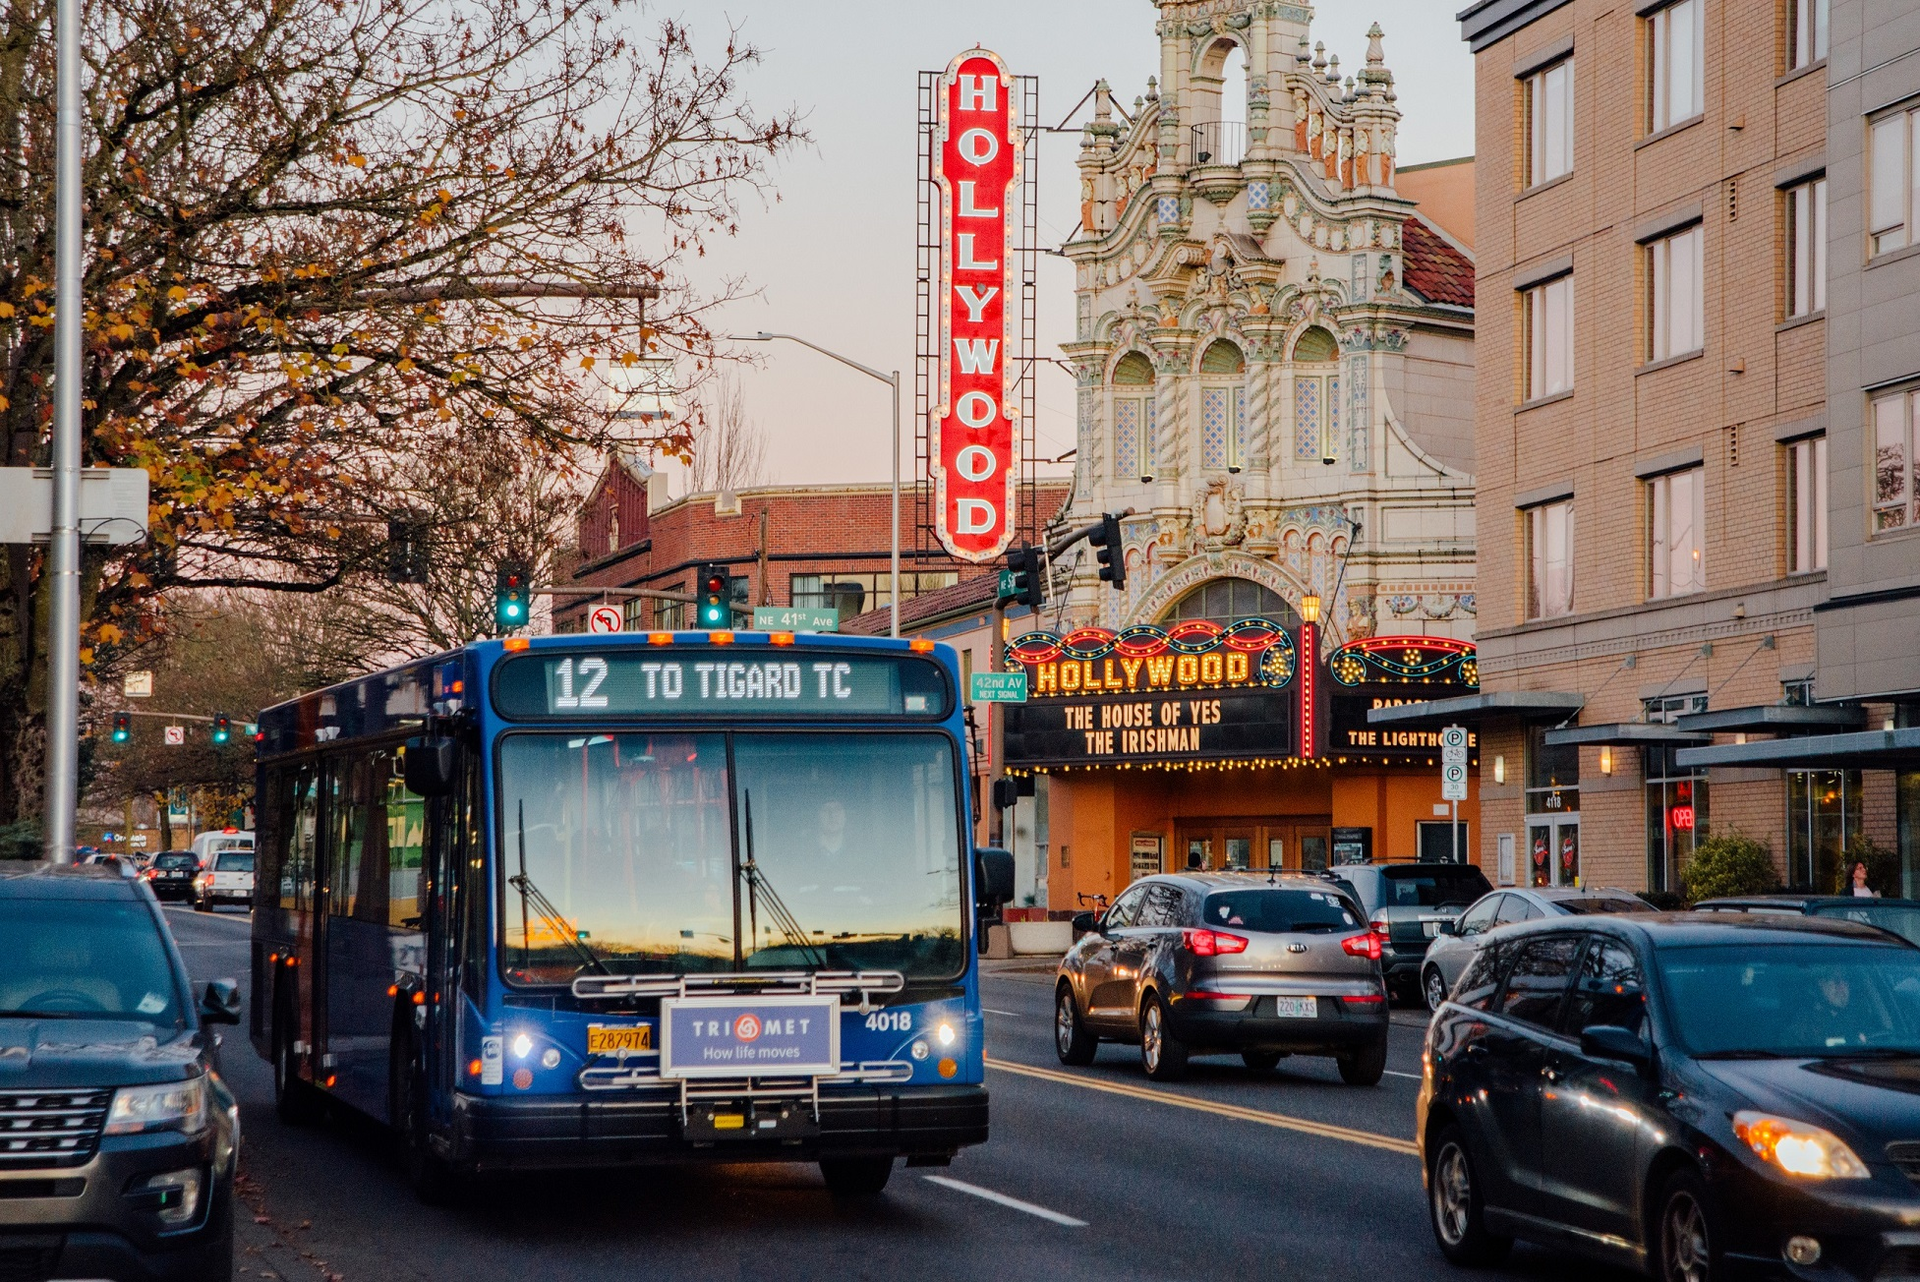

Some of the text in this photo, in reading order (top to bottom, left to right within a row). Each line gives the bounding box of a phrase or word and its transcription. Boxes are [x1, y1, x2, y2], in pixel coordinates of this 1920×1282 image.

[953, 74, 1000, 536] HOLLYWOOD
[759, 612, 833, 627] NE 41st Ave
[1037, 652, 1249, 692] HOLLYWOOD
[556, 657, 851, 708] 12 TO TIGARD TC
[976, 677, 1023, 689] 42nd AV
[979, 690, 1019, 699] NEXT SIGNAL
[1064, 700, 1221, 730] THE HOUSE OF YES
[1085, 727, 1200, 755] THE IRISHMAN
[1348, 731, 1377, 746] THE
[865, 1012, 912, 1031] 4018
[703, 1045, 800, 1060] How life moves
